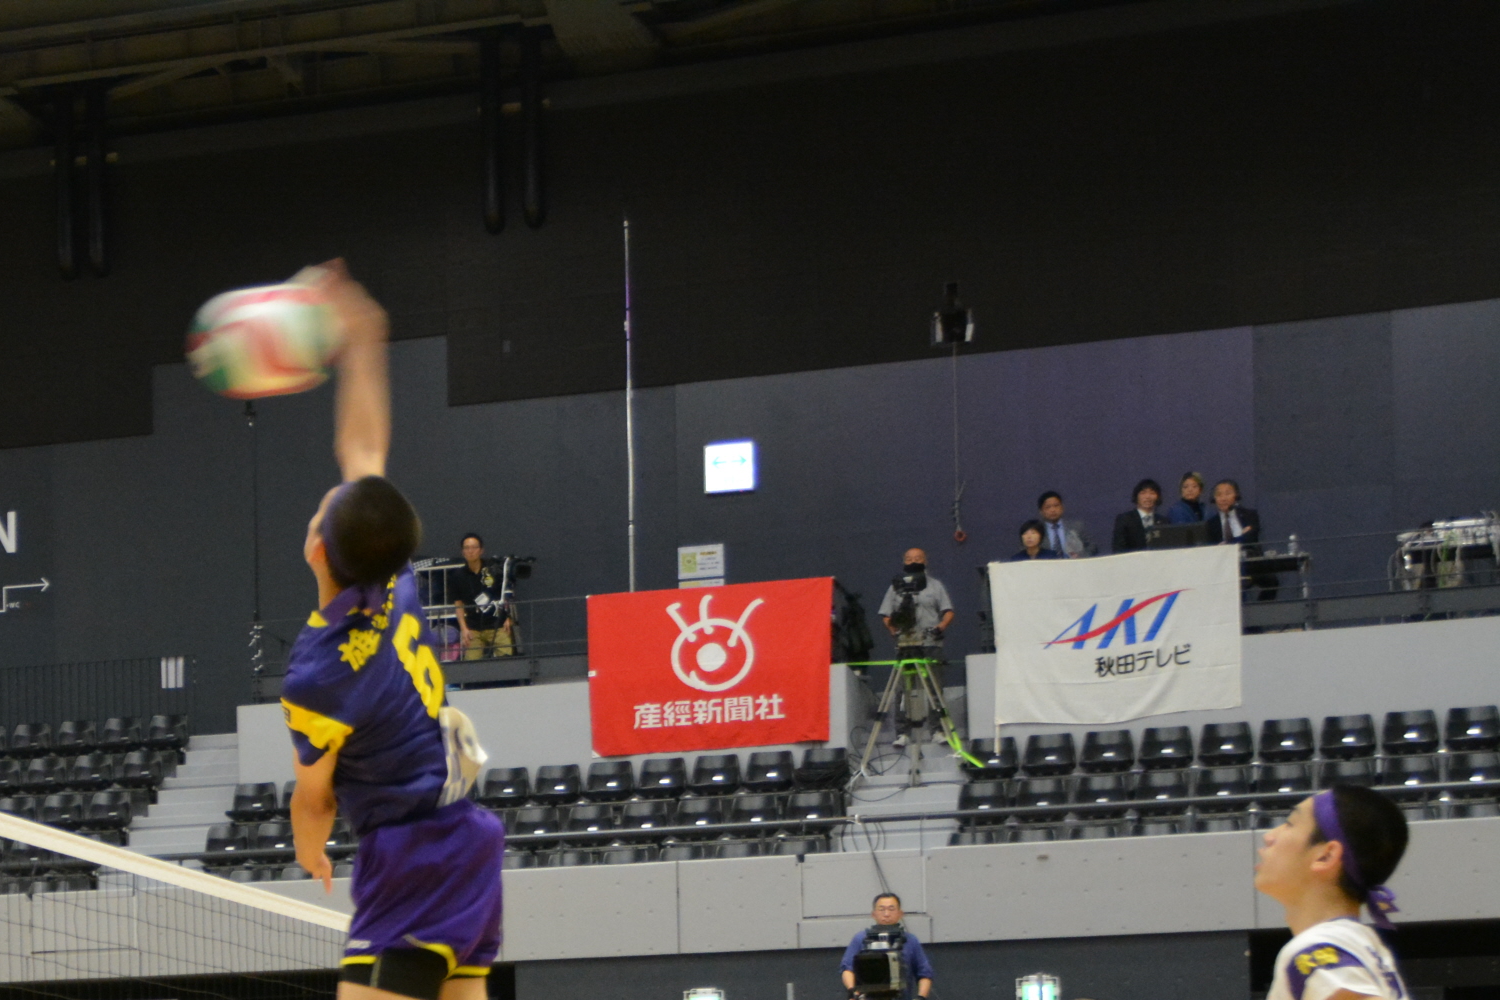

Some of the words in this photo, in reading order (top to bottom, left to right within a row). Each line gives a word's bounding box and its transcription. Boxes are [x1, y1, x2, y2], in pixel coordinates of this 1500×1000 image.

[1095, 643, 1192, 678] 秋田テレビ
